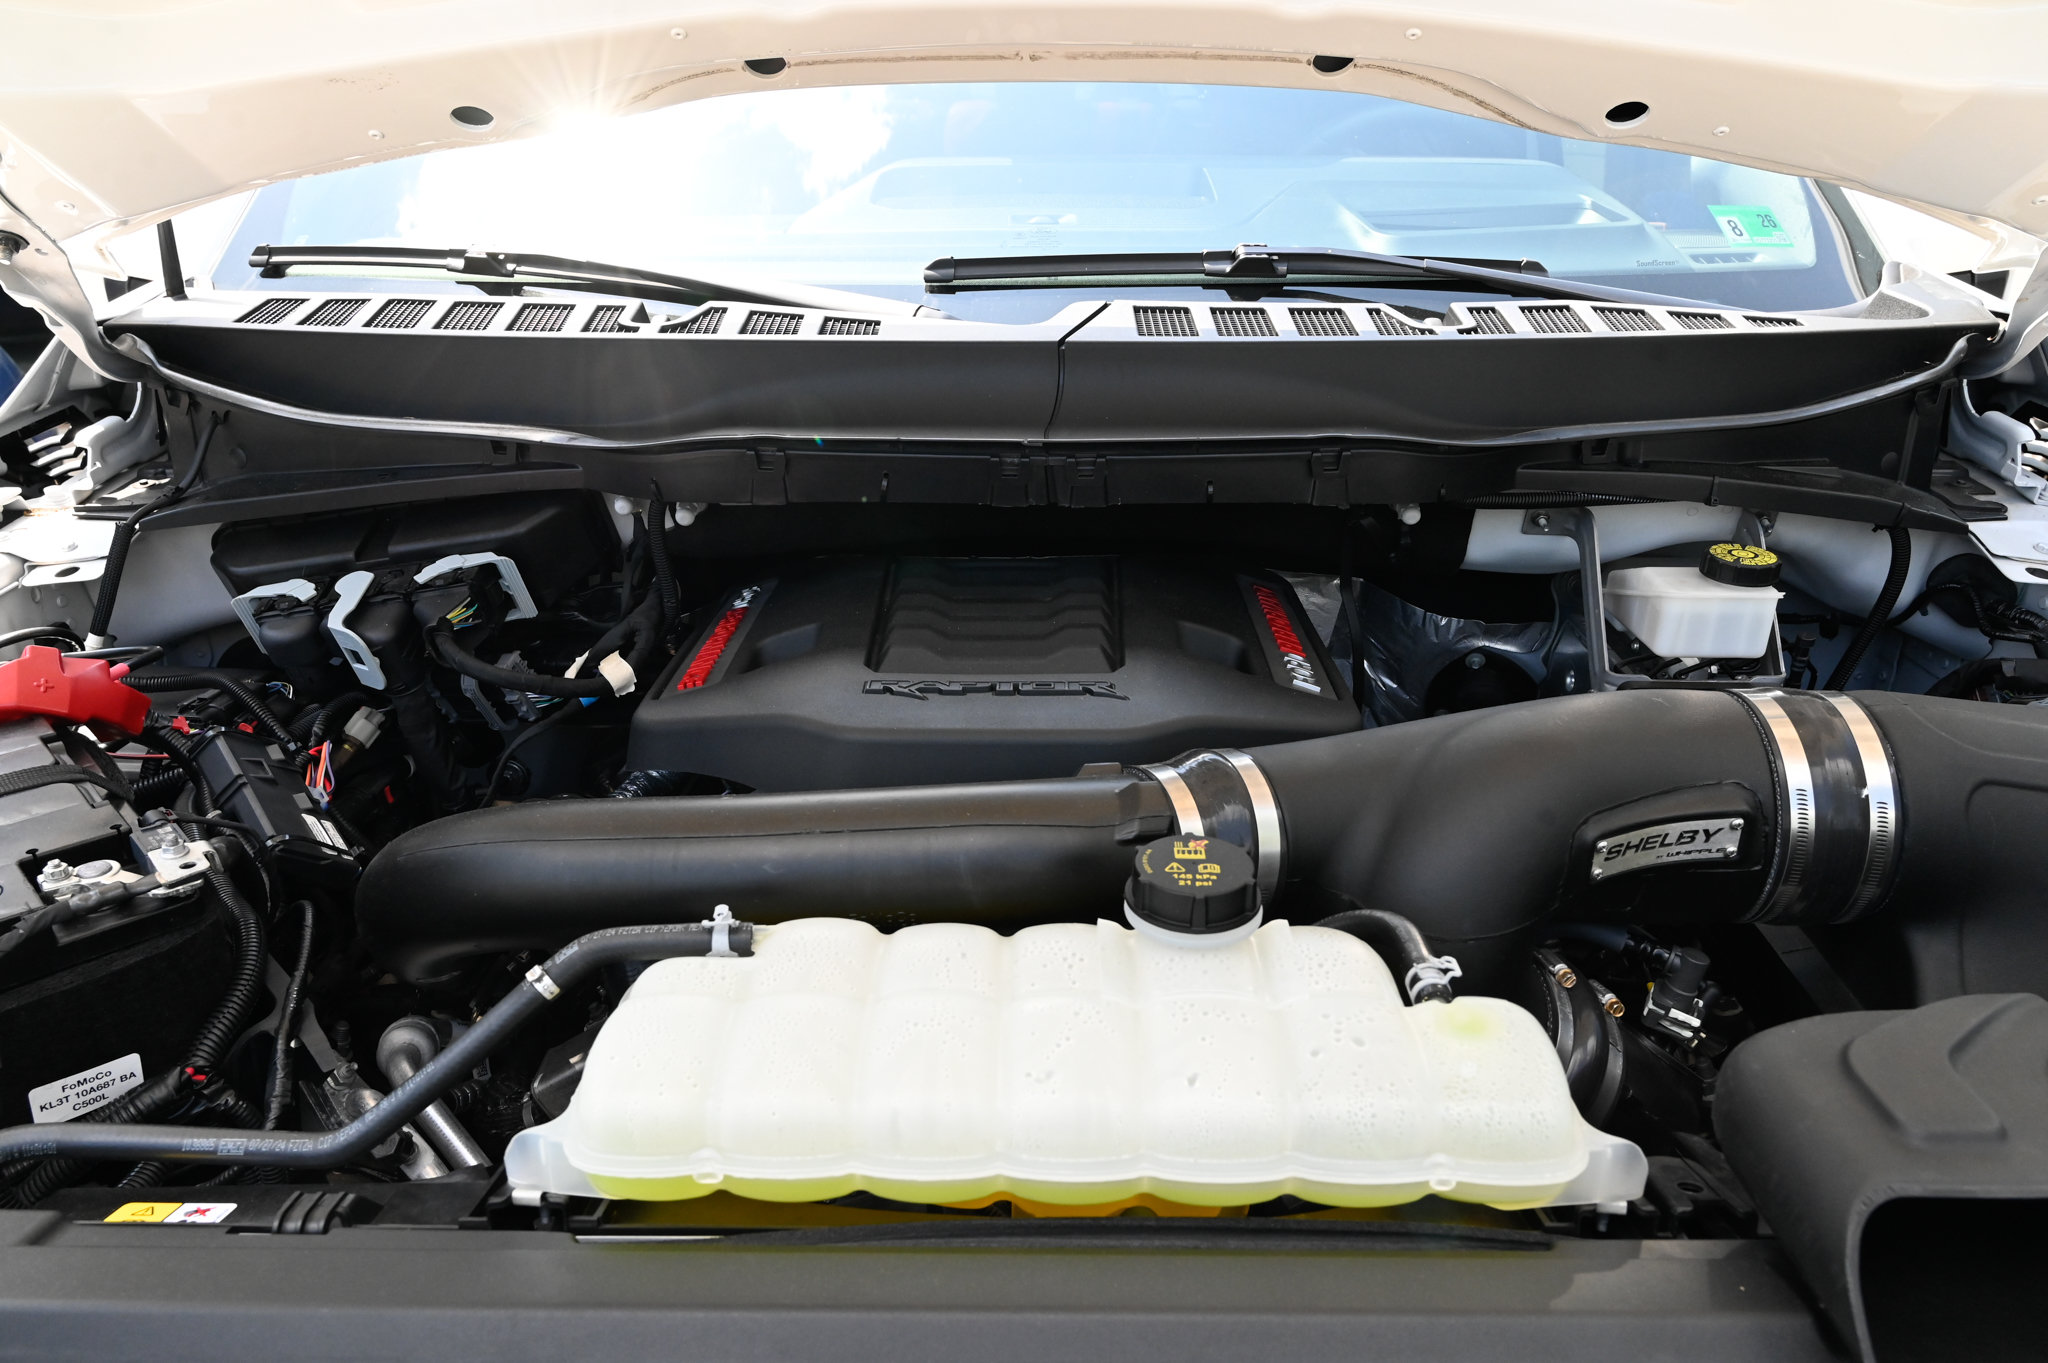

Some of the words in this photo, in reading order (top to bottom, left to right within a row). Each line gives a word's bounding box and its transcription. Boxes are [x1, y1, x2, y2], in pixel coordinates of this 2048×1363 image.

[1726, 218, 1744, 237] 8
[1756, 213, 1778, 229] 26
[862, 680, 1131, 700] RAPTOR
[1603, 827, 1725, 862] SHELBY
[39, 1095, 71, 1112] KL3T
[75, 1079, 116, 1099] 10A687
[120, 1071, 137, 1083] BA
[61, 1070, 112, 1093] FoMoCo
[72, 1093, 110, 1111] C500L
